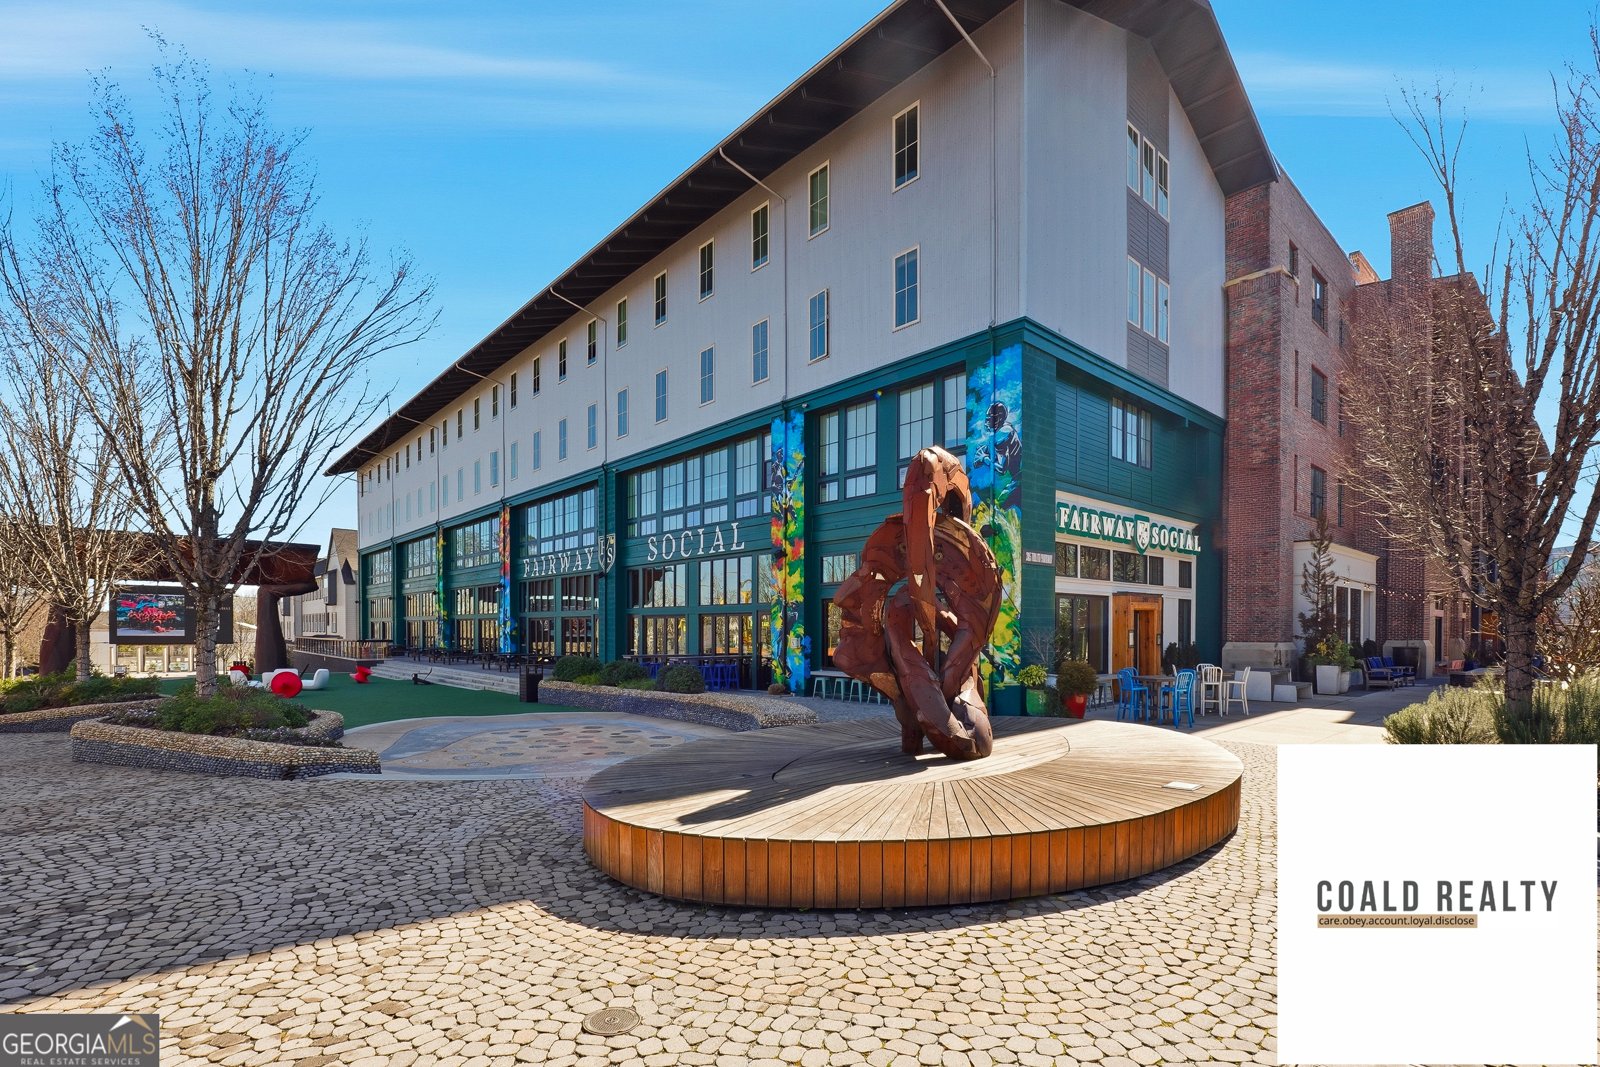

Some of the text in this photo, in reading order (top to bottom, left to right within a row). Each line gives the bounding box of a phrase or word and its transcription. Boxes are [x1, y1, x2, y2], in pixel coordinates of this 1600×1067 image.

[523, 522, 745, 577] FAIRWAY SOCIAL
[1059, 507, 1134, 540] FAIRWAY
[1152, 526, 1201, 552] SOCIAL
